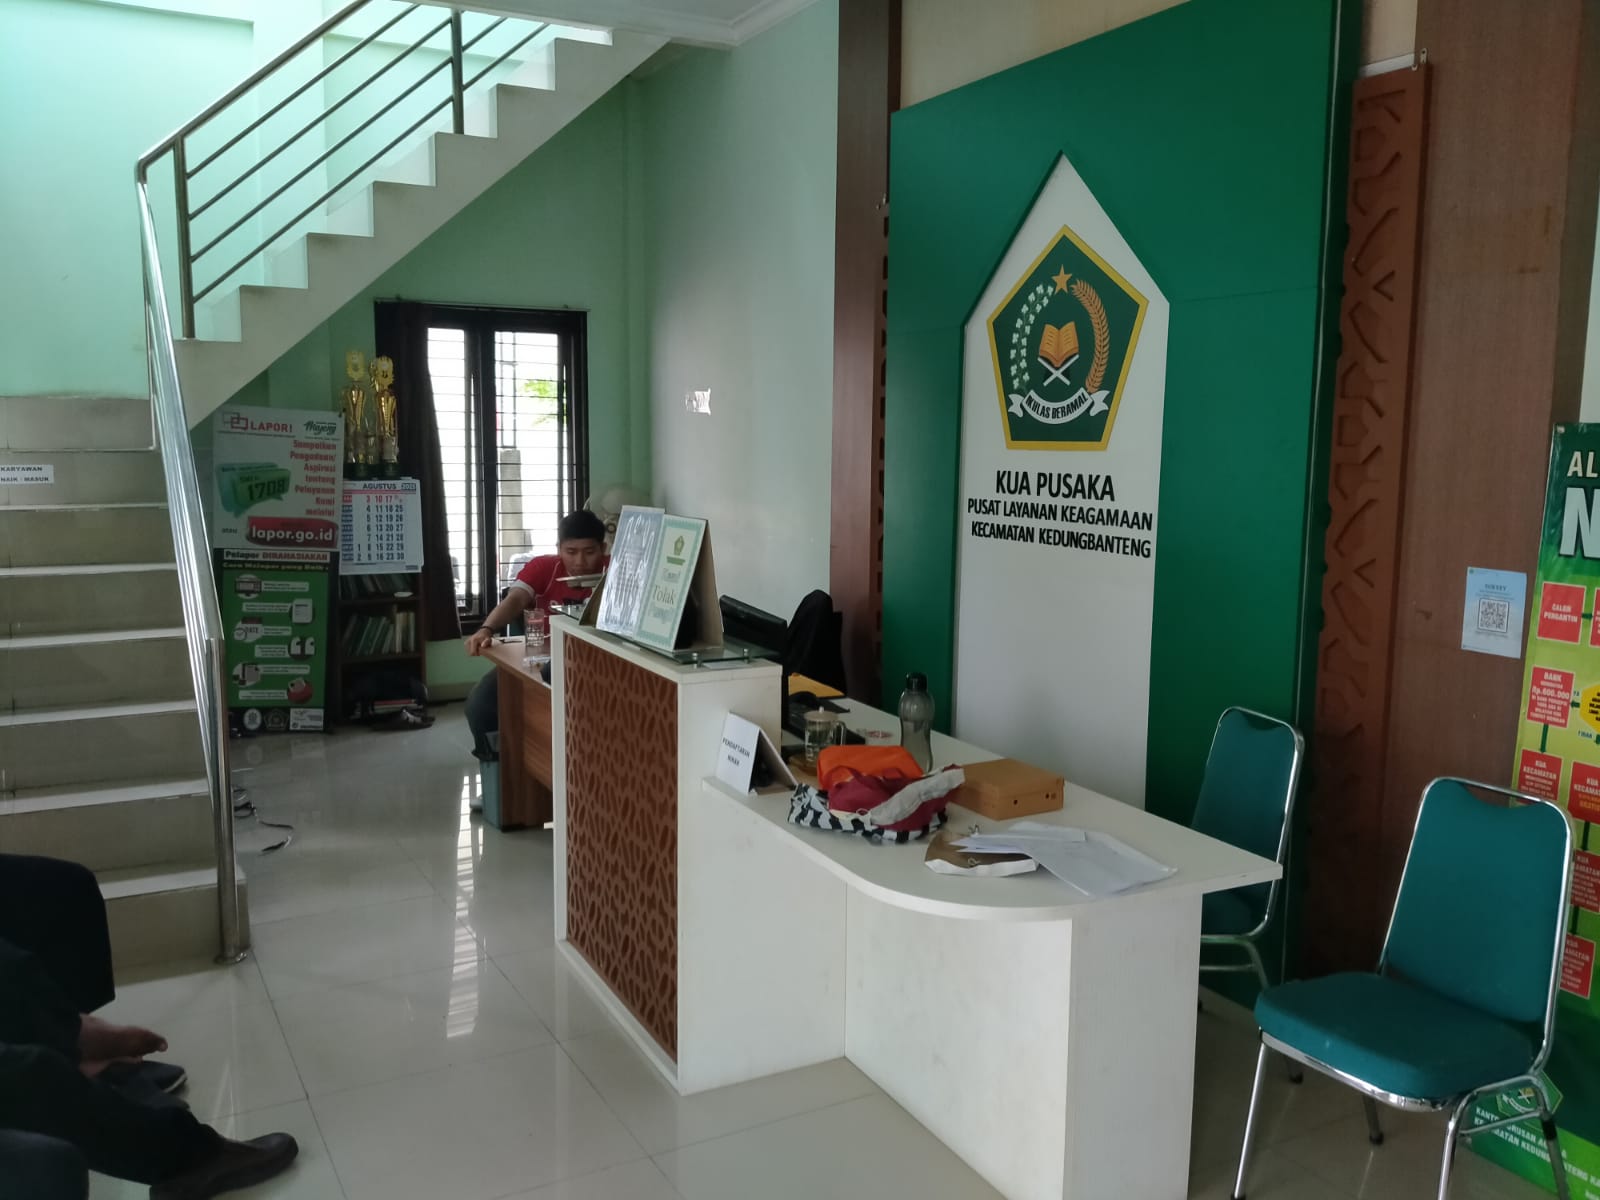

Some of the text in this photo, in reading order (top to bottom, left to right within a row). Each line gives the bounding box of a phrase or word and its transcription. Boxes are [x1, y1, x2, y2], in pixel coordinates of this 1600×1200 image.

[1025, 392, 1088, 420] IKHLAS BERAMAL
[250, 421, 293, 433] LAPOR!
[293, 440, 337, 451] Sampaikan
[304, 463, 336, 473] Aspirasi
[996, 470, 1115, 502] KUA PUSAKA
[968, 498, 1152, 531] PUSAT LAYANAN KEAGAMAAN
[252, 525, 333, 543] lapor.go.id
[971, 521, 1151, 559] KECAMATAN KEDUNGBANTENG
[225, 551, 260, 560] Pelapor
[1543, 672, 1562, 682] BANK
[722, 737, 751, 759] PENDAFTARAN
